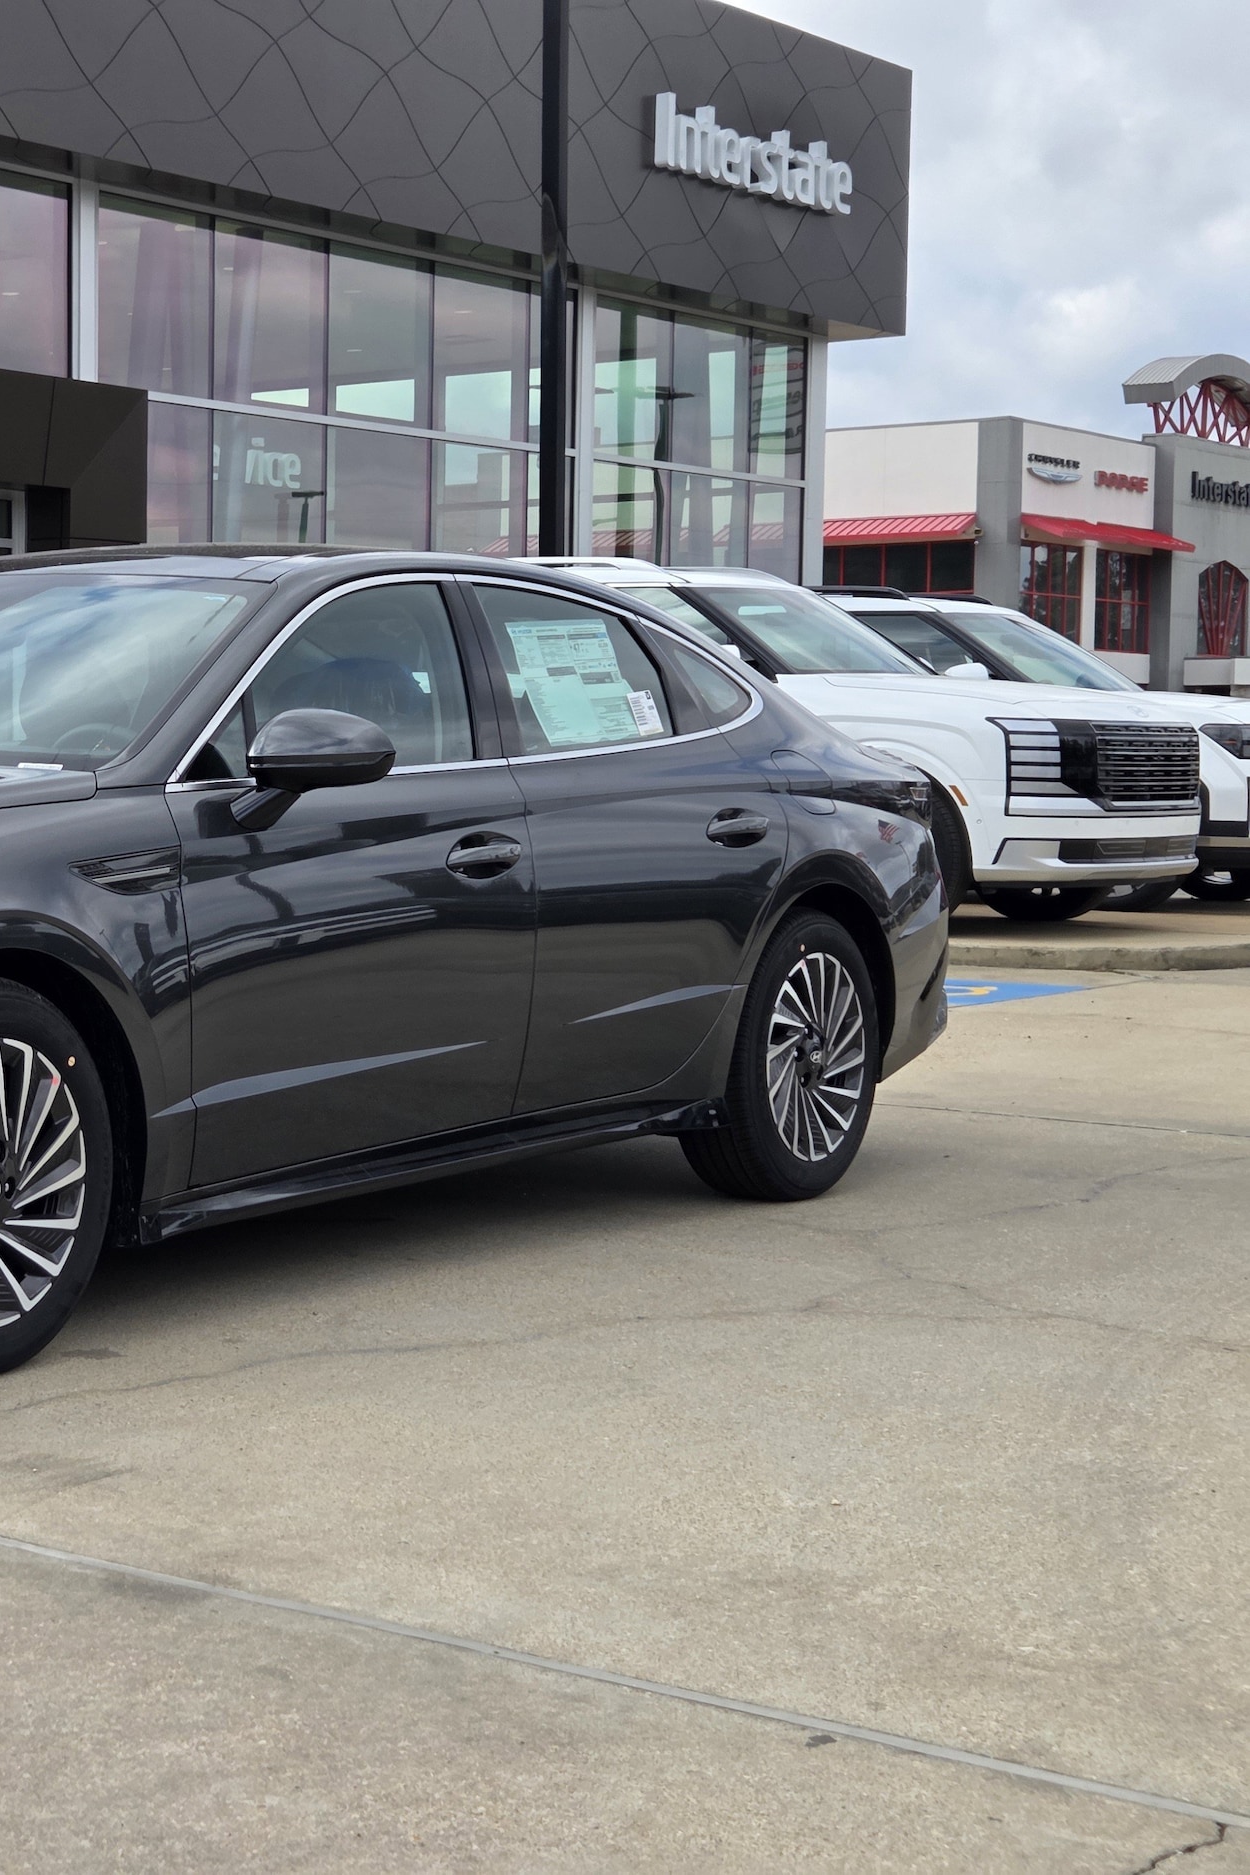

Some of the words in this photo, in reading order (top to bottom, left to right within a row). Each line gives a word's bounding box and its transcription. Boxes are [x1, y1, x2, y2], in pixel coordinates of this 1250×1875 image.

[654, 91, 853, 215] Interstate
[1094, 470, 1149, 494] DODGE
[1191, 471, 1250, 507] Intersta
